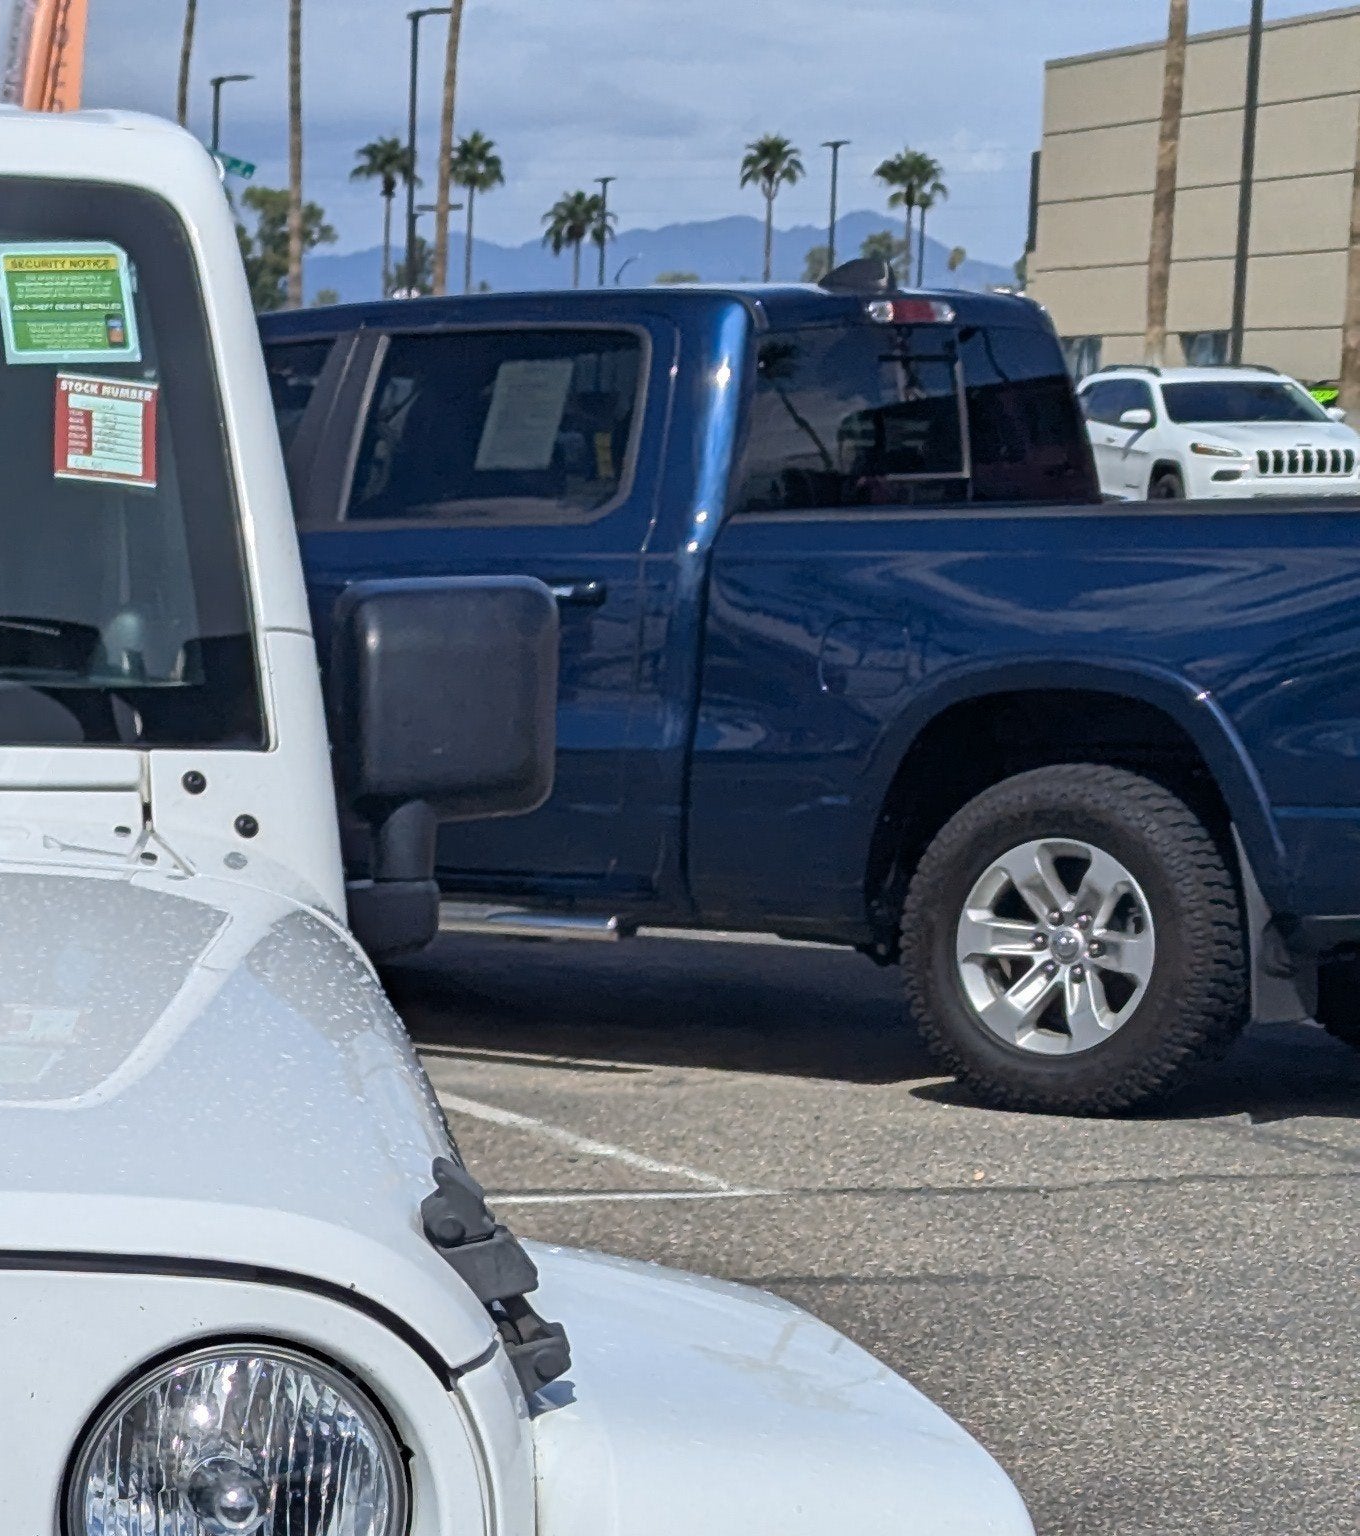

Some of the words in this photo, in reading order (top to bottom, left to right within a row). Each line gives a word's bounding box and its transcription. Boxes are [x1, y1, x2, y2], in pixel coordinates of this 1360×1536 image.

[11, 258, 66, 270] SECURITY
[69, 258, 110, 270] NOTICE
[60, 380, 99, 394] STOCK
[101, 385, 153, 401] NUMBER
